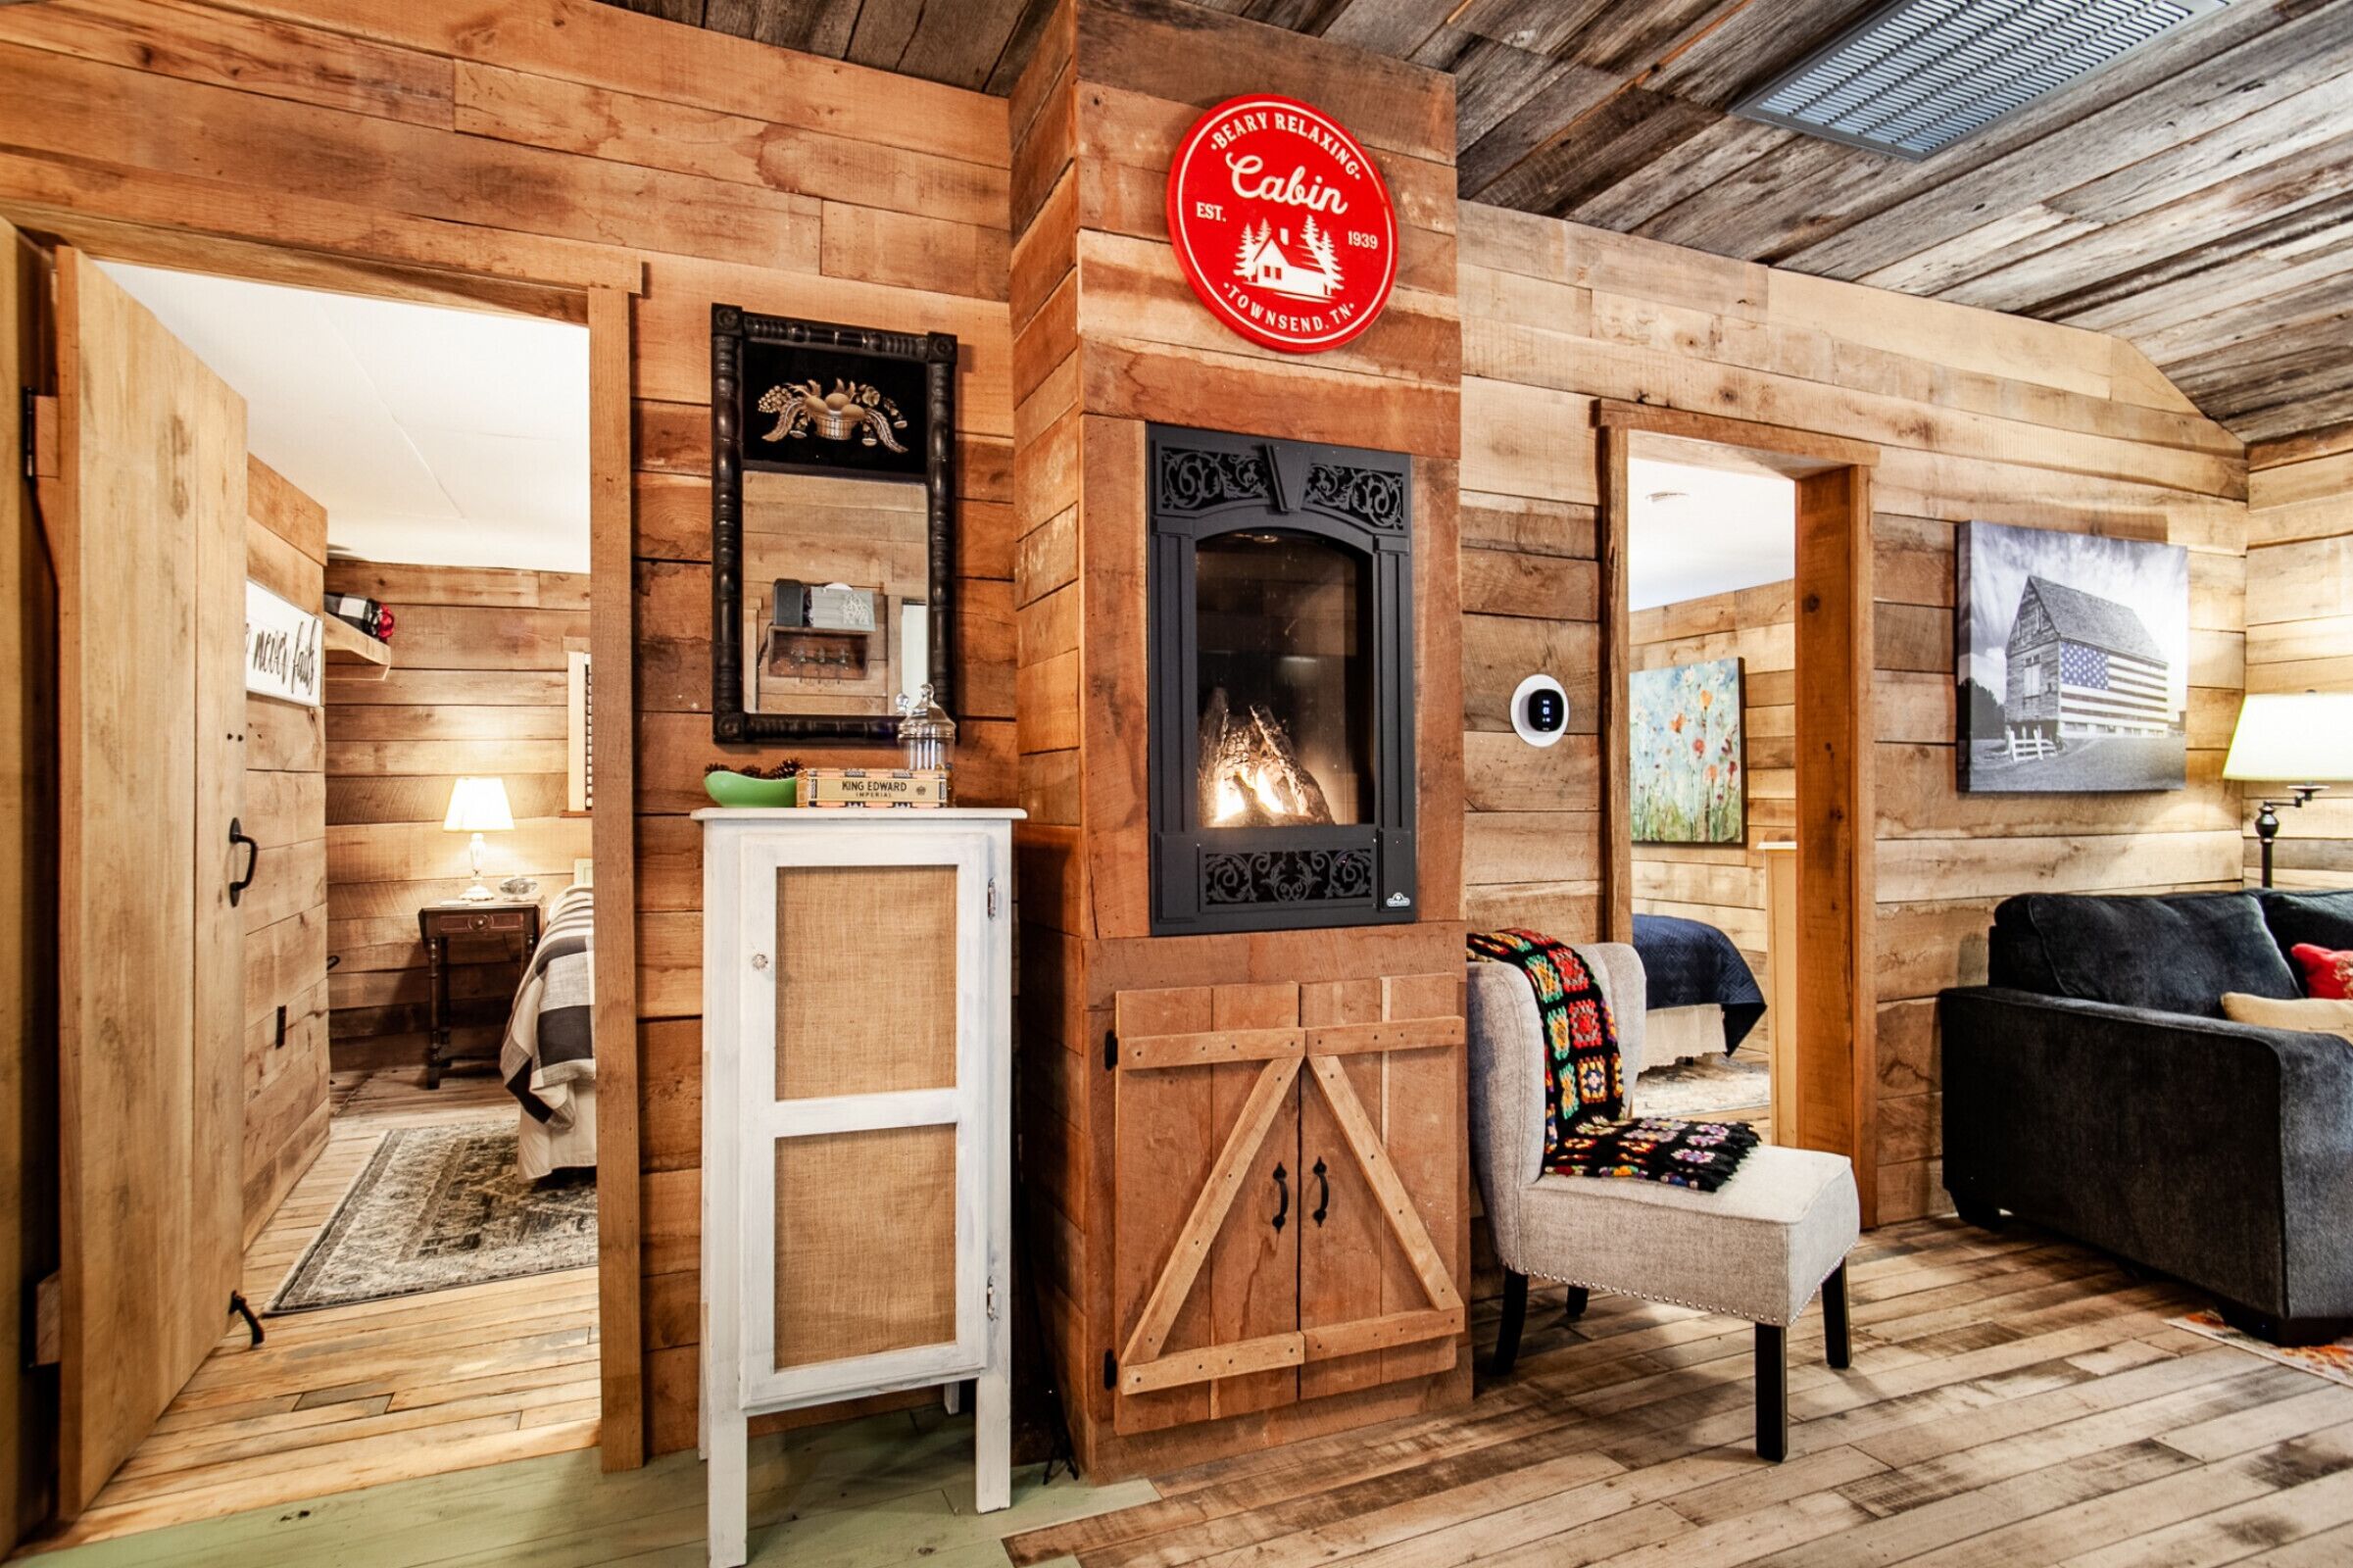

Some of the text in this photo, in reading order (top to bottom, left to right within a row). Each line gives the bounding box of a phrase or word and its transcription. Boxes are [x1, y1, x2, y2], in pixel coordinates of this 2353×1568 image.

[1213, 112, 1360, 176] BEARY RELAXING
[1225, 152, 1348, 215] Cabin
[1196, 201, 1227, 222] EST.
[1348, 230, 1379, 250] 1939
[1329, 303, 1352, 325] TN
[842, 781, 907, 792] KING EDWARD
